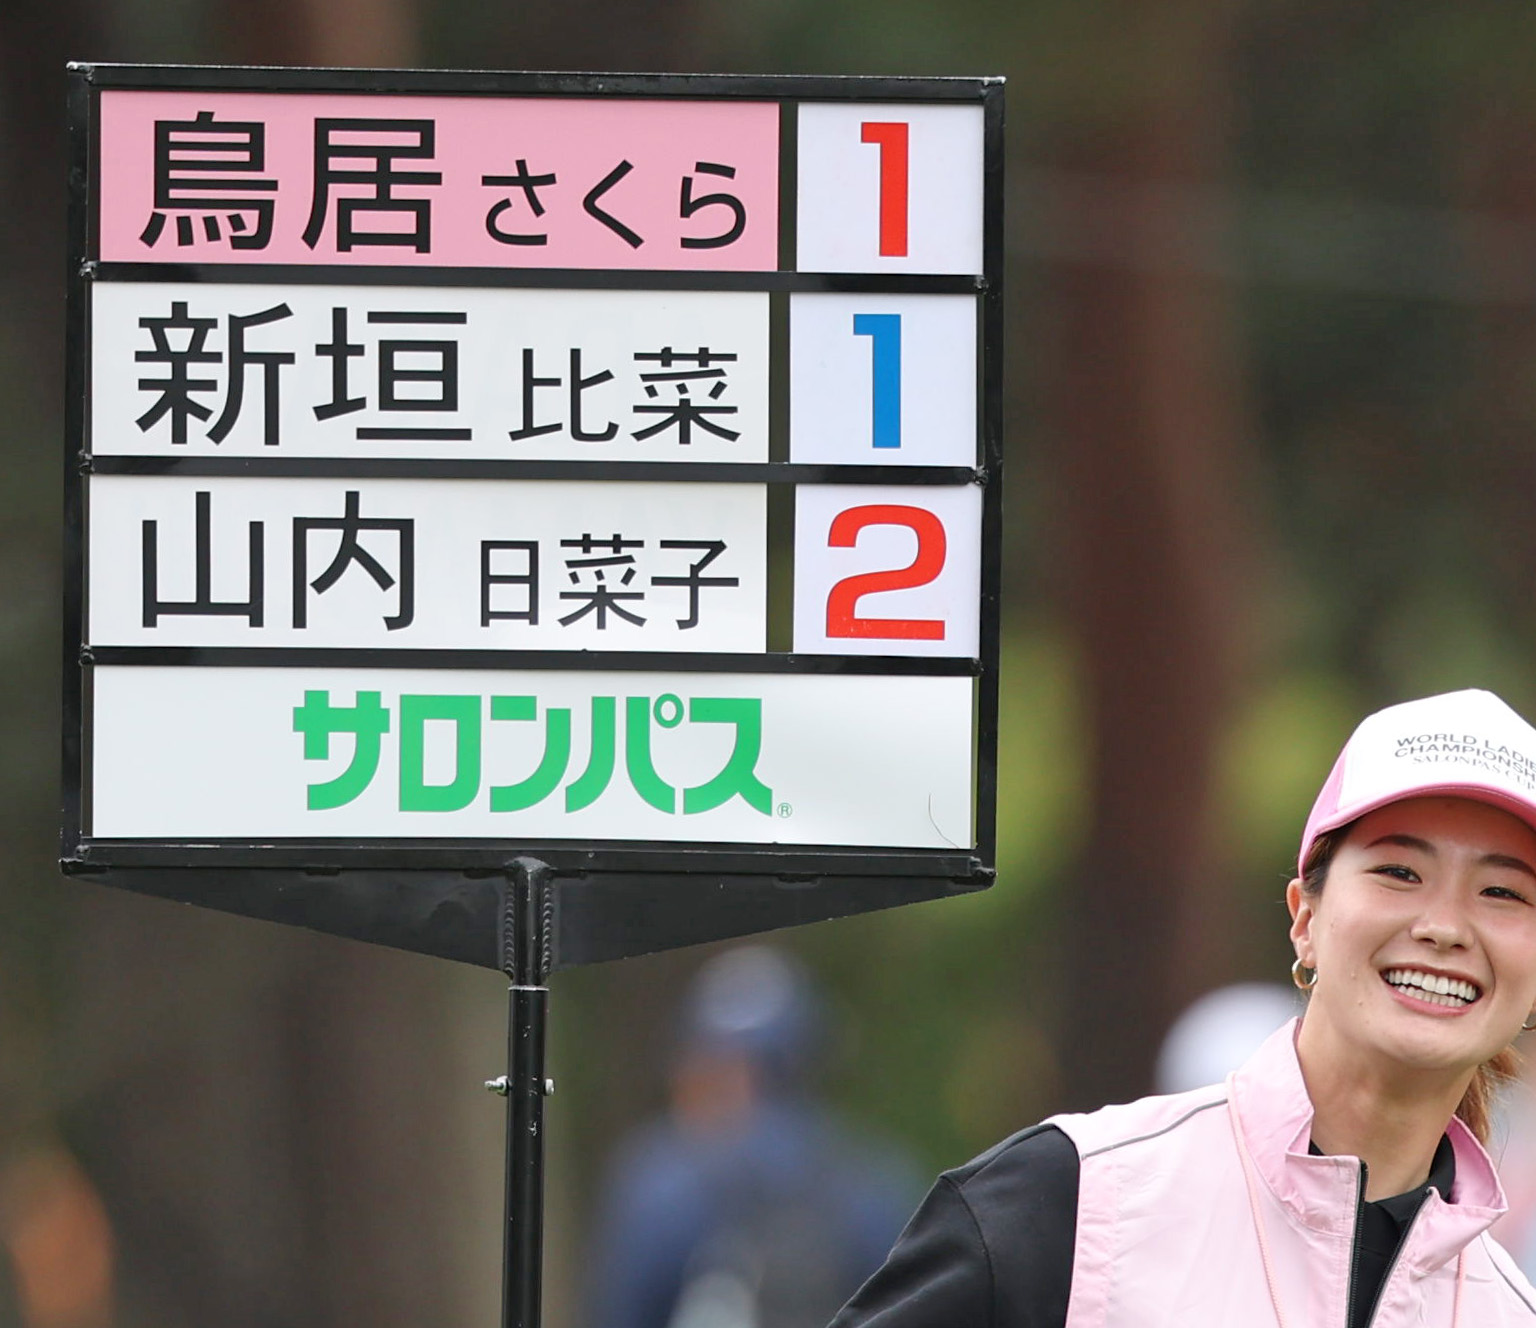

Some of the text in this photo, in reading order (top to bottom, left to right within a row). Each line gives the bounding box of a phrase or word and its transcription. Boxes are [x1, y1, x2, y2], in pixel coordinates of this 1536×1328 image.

[140, 112, 745, 253] 鳥居 さくら
[862, 123, 908, 256] 1
[135, 302, 740, 445] 新垣 比菜
[854, 314, 901, 448] 1
[143, 491, 738, 630] 山内 日菜子
[827, 505, 945, 639] 2
[294, 691, 772, 814] サロンパス
[1397, 733, 1477, 747] WORLD
[1412, 754, 1501, 774] SALONPAS
